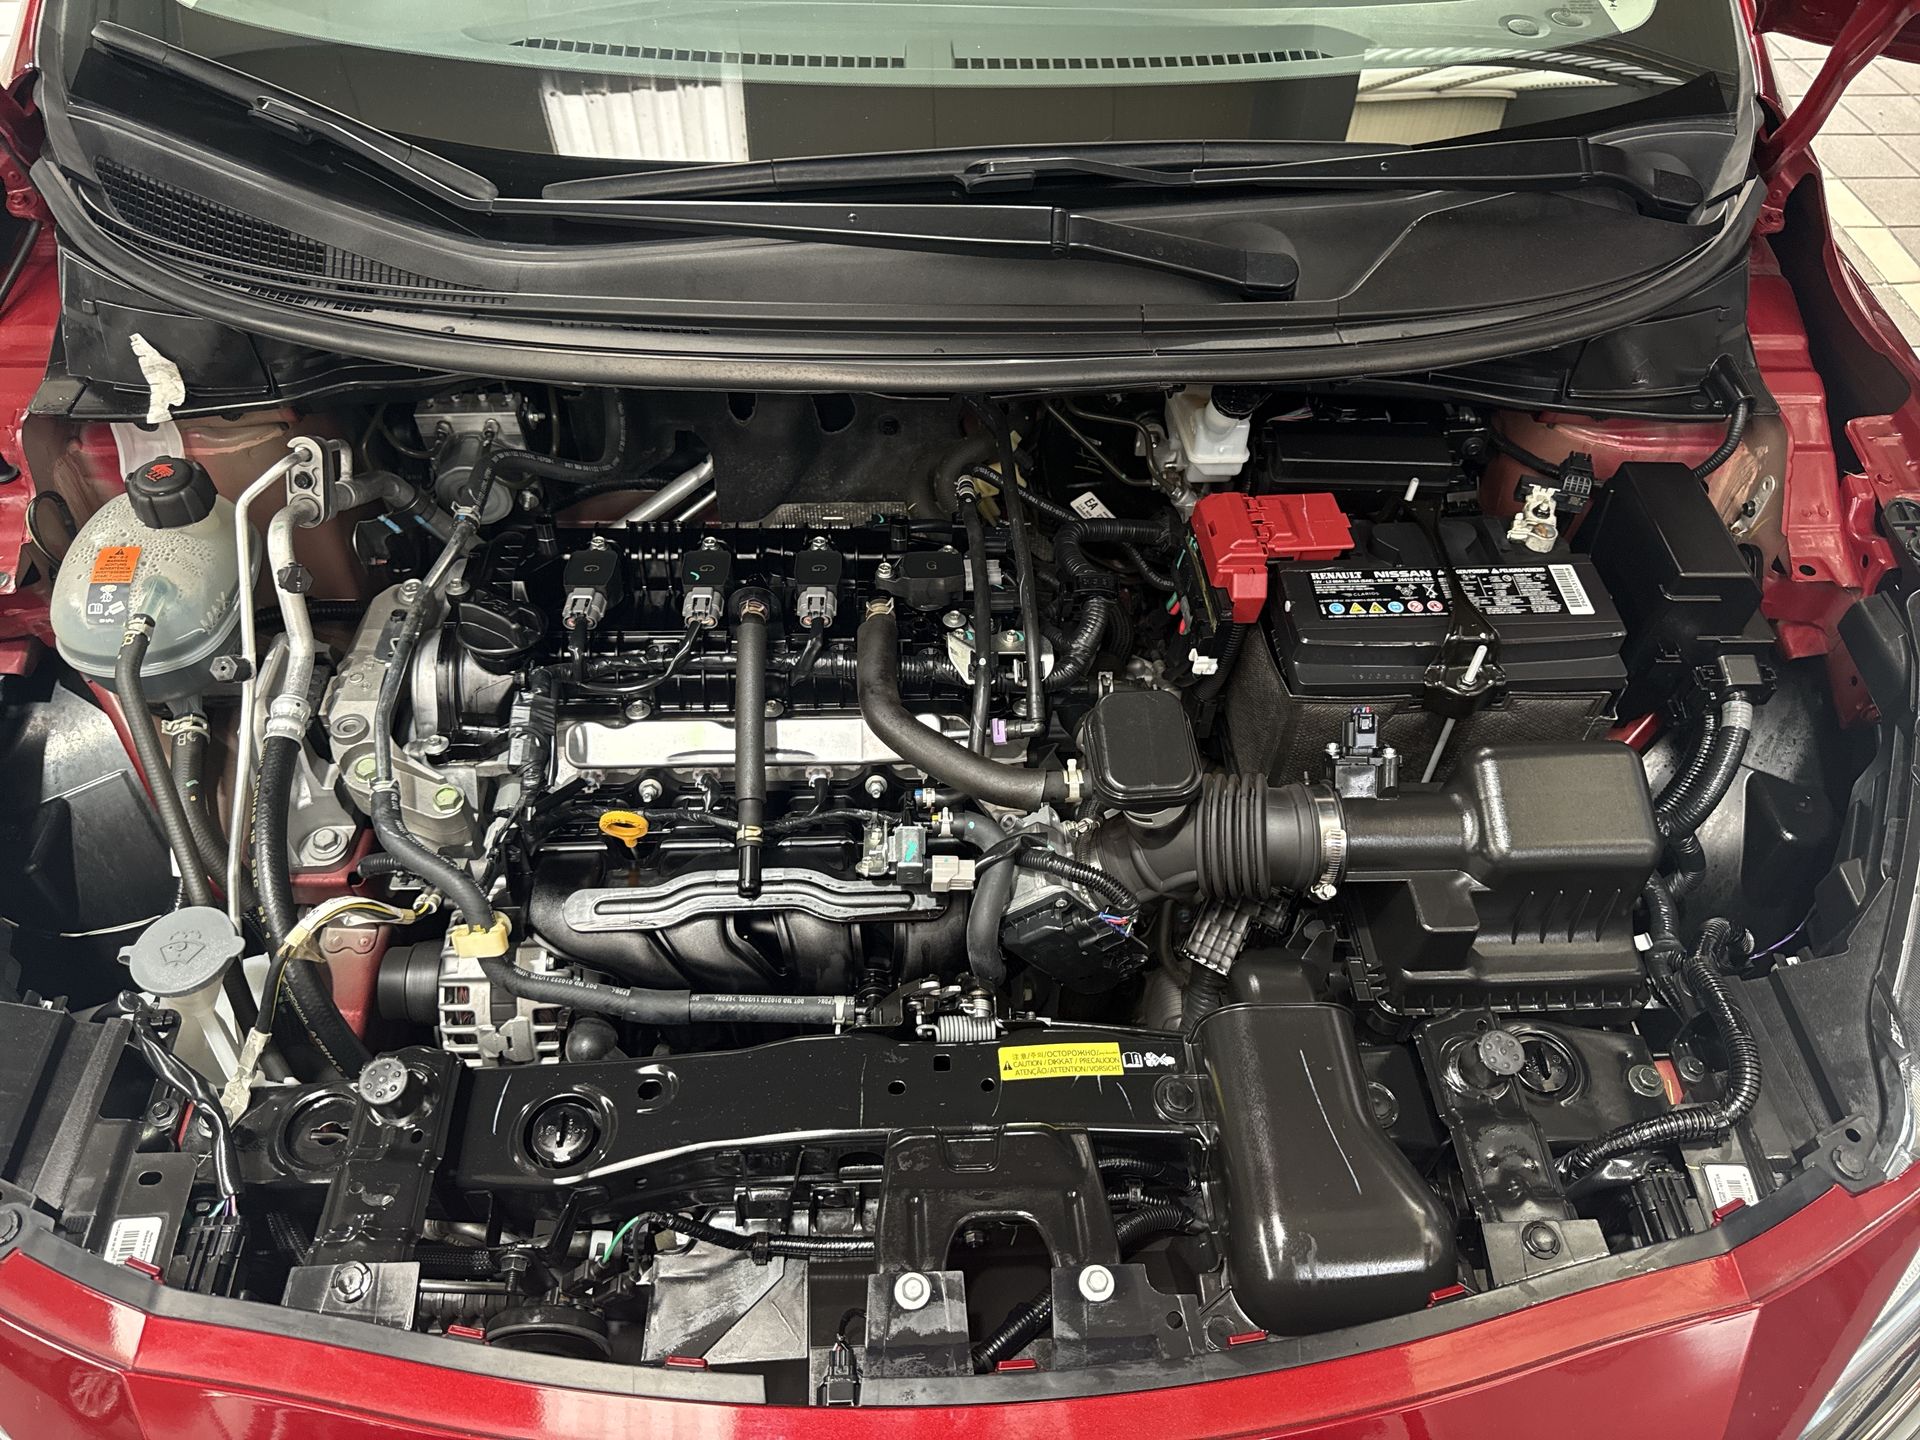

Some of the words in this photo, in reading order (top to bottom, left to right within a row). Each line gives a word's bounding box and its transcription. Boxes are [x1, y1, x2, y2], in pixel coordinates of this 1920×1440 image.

[1085, 498, 1098, 510] EA
[926, 560, 937, 571] G
[1310, 571, 1362, 580] RENAULT
[1373, 570, 1432, 578] NISSAN
[285, 985, 309, 1025] YOKOHAMA
[1013, 1059, 1043, 1068] CAUTION
